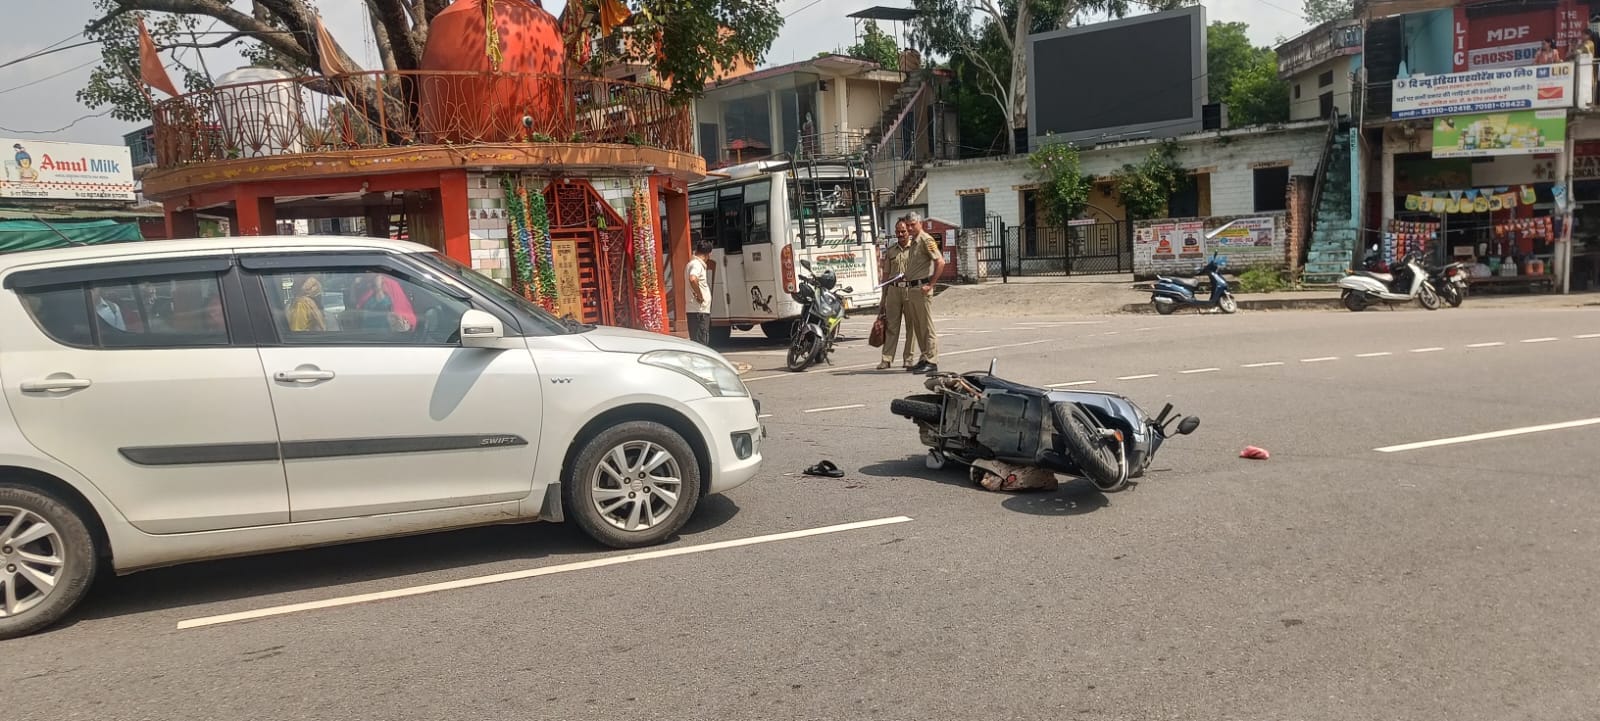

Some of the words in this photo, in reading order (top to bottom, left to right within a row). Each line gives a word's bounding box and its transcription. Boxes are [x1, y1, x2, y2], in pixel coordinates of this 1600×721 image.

[1487, 26, 1530, 41] MDF
[1552, 66, 1568, 77] LIC
[41, 154, 87, 172] Amul
[90, 159, 120, 173] Milk
[481, 437, 517, 446] SWIFT
